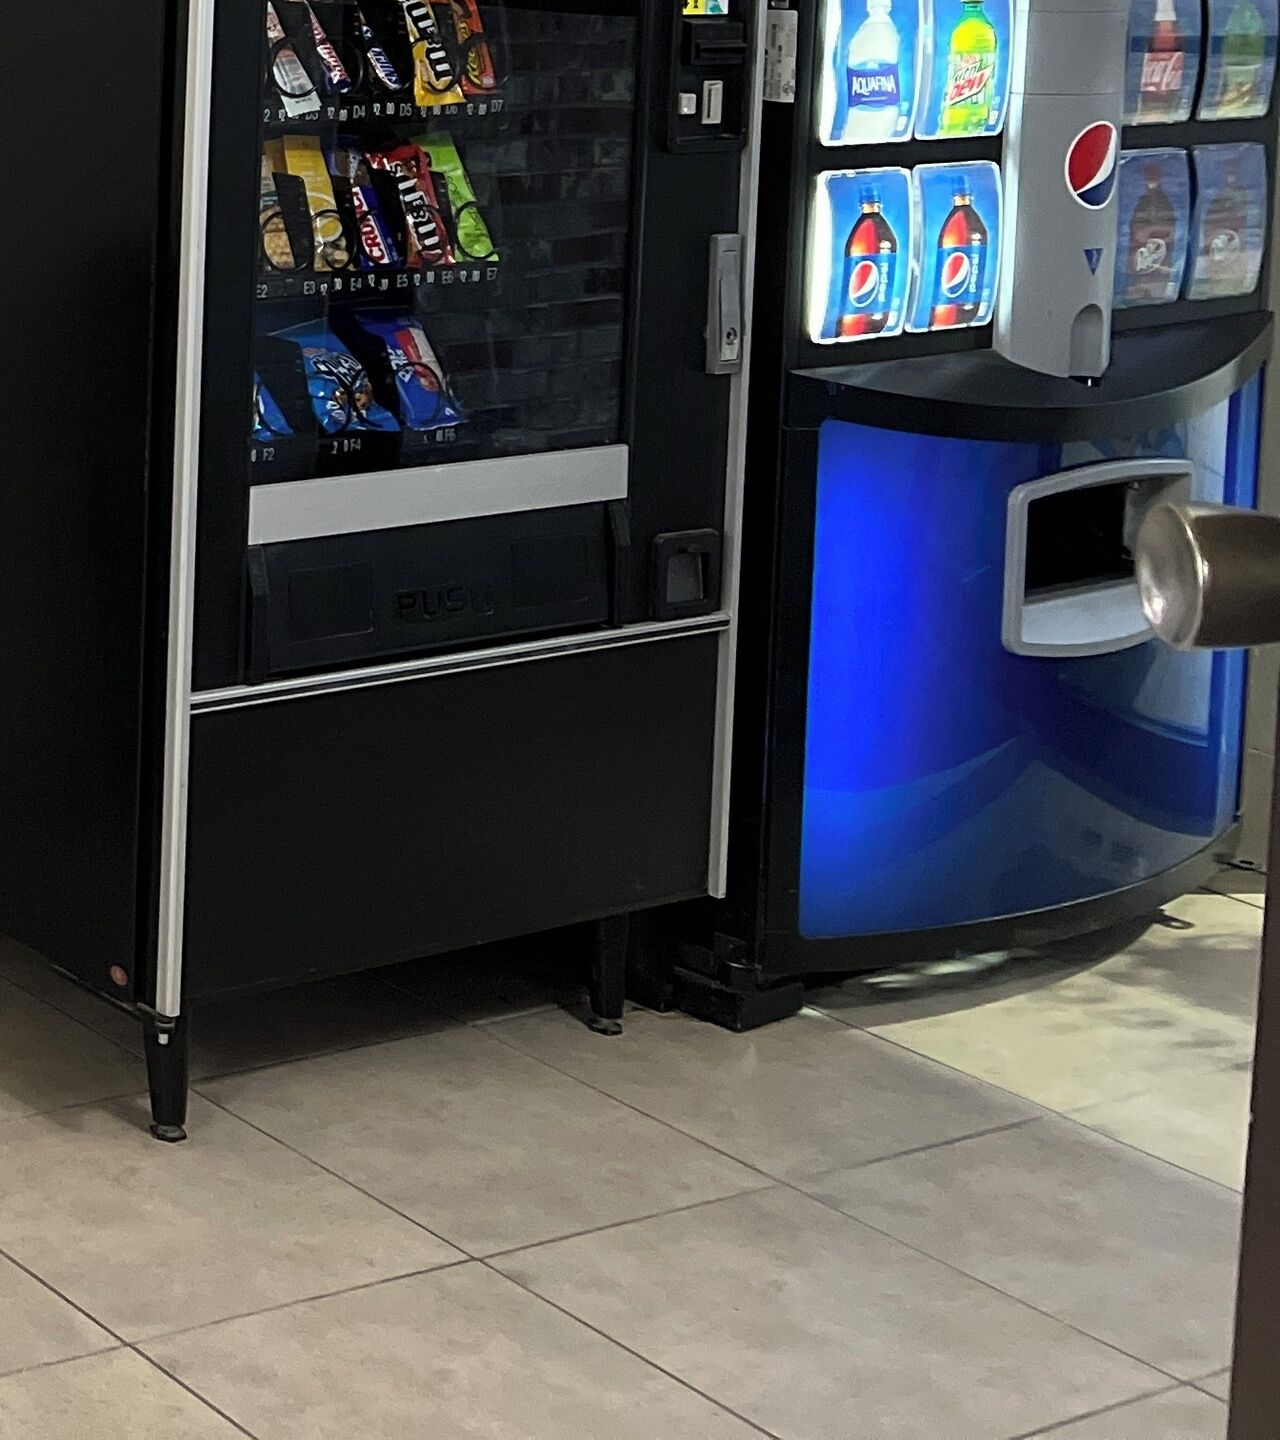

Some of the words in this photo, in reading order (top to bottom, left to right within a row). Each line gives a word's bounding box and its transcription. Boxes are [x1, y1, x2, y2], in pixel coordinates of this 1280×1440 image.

[851, 74, 897, 96] AQUAFINA
[352, 104, 366, 119] D4
[399, 103, 413, 117] D5
[491, 99, 505, 112] D7
[396, 273, 409, 288] E5
[441, 270, 454, 284] E6
[486, 267, 498, 281] E7
[303, 281, 316, 295] E3
[350, 277, 362, 292] E4
[350, 439, 361, 452] F4
[263, 447, 275, 461] F2
